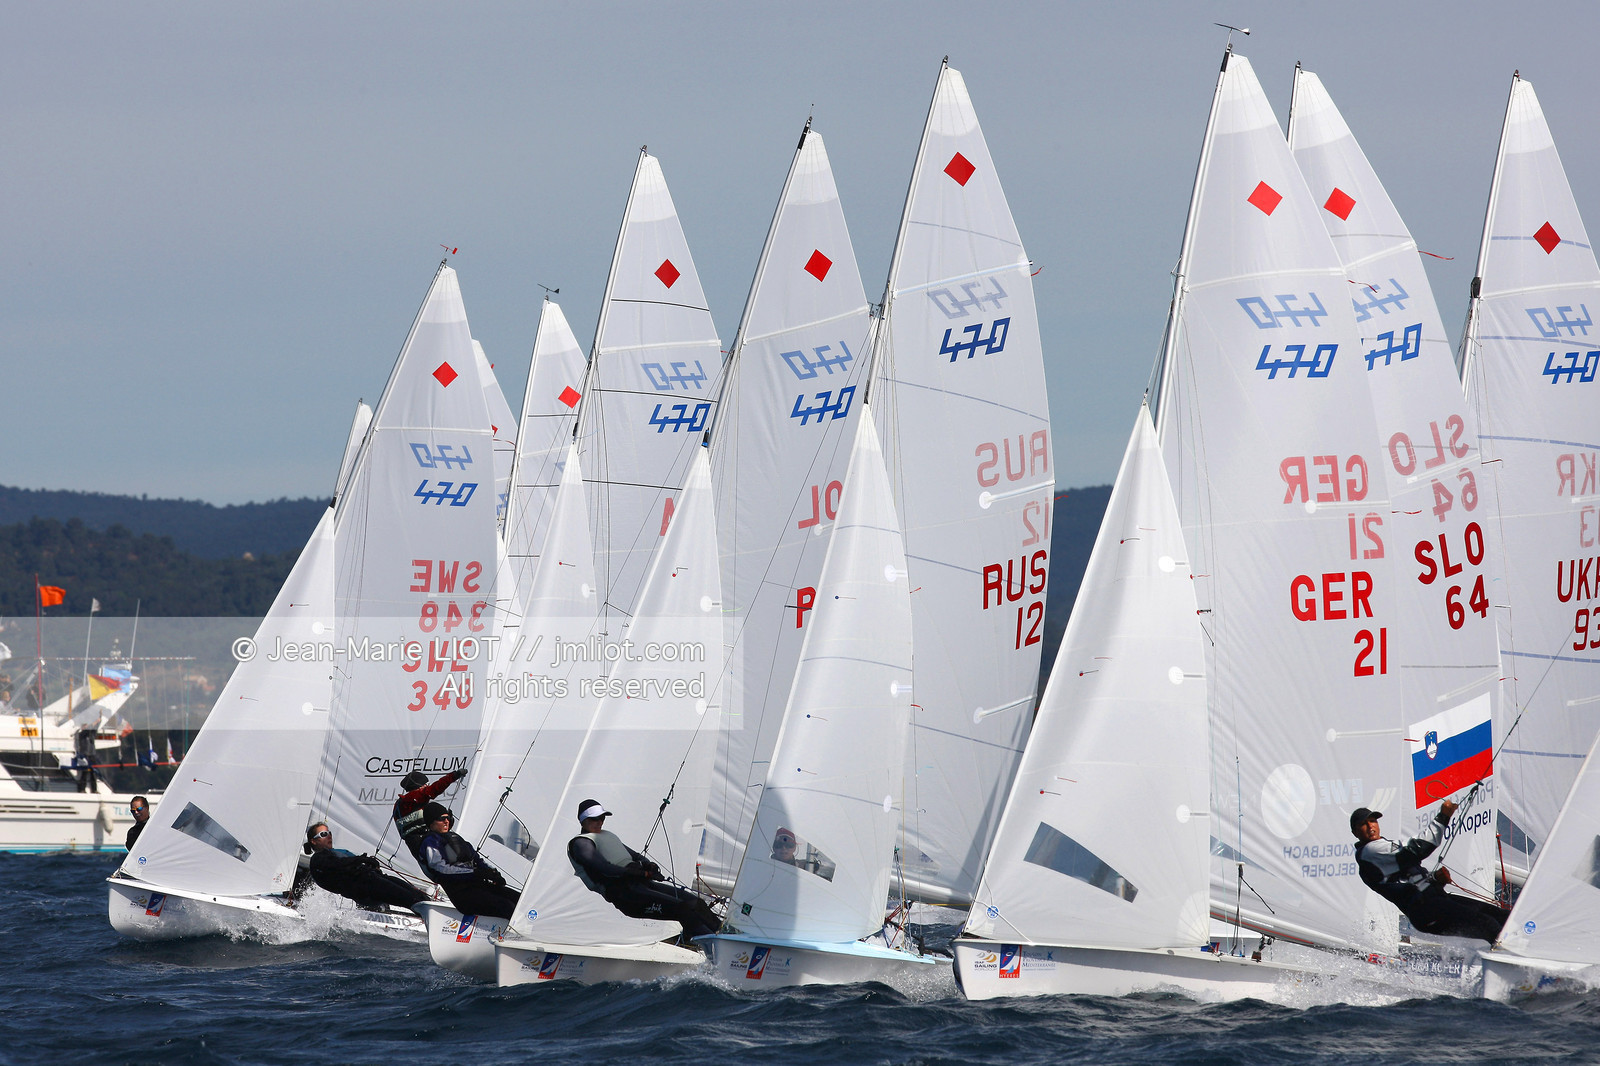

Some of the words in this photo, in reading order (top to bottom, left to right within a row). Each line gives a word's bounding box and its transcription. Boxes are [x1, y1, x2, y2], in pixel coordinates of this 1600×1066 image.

[938, 317, 1011, 362] 470
[1255, 344, 1339, 380] 470
[1542, 351, 1600, 384] 470
[648, 404, 711, 433] 470
[790, 385, 856, 426] 470
[414, 479, 478, 507] 470
[1414, 521, 1485, 585] SLO
[983, 549, 1047, 610] RUS
[1290, 571, 1374, 621] GER
[1445, 574, 1489, 630] 64
[1015, 600, 1043, 650] 12
[402, 640, 472, 672] SWE
[1353, 627, 1387, 677] 21
[365, 756, 467, 773] CASTELLUM
